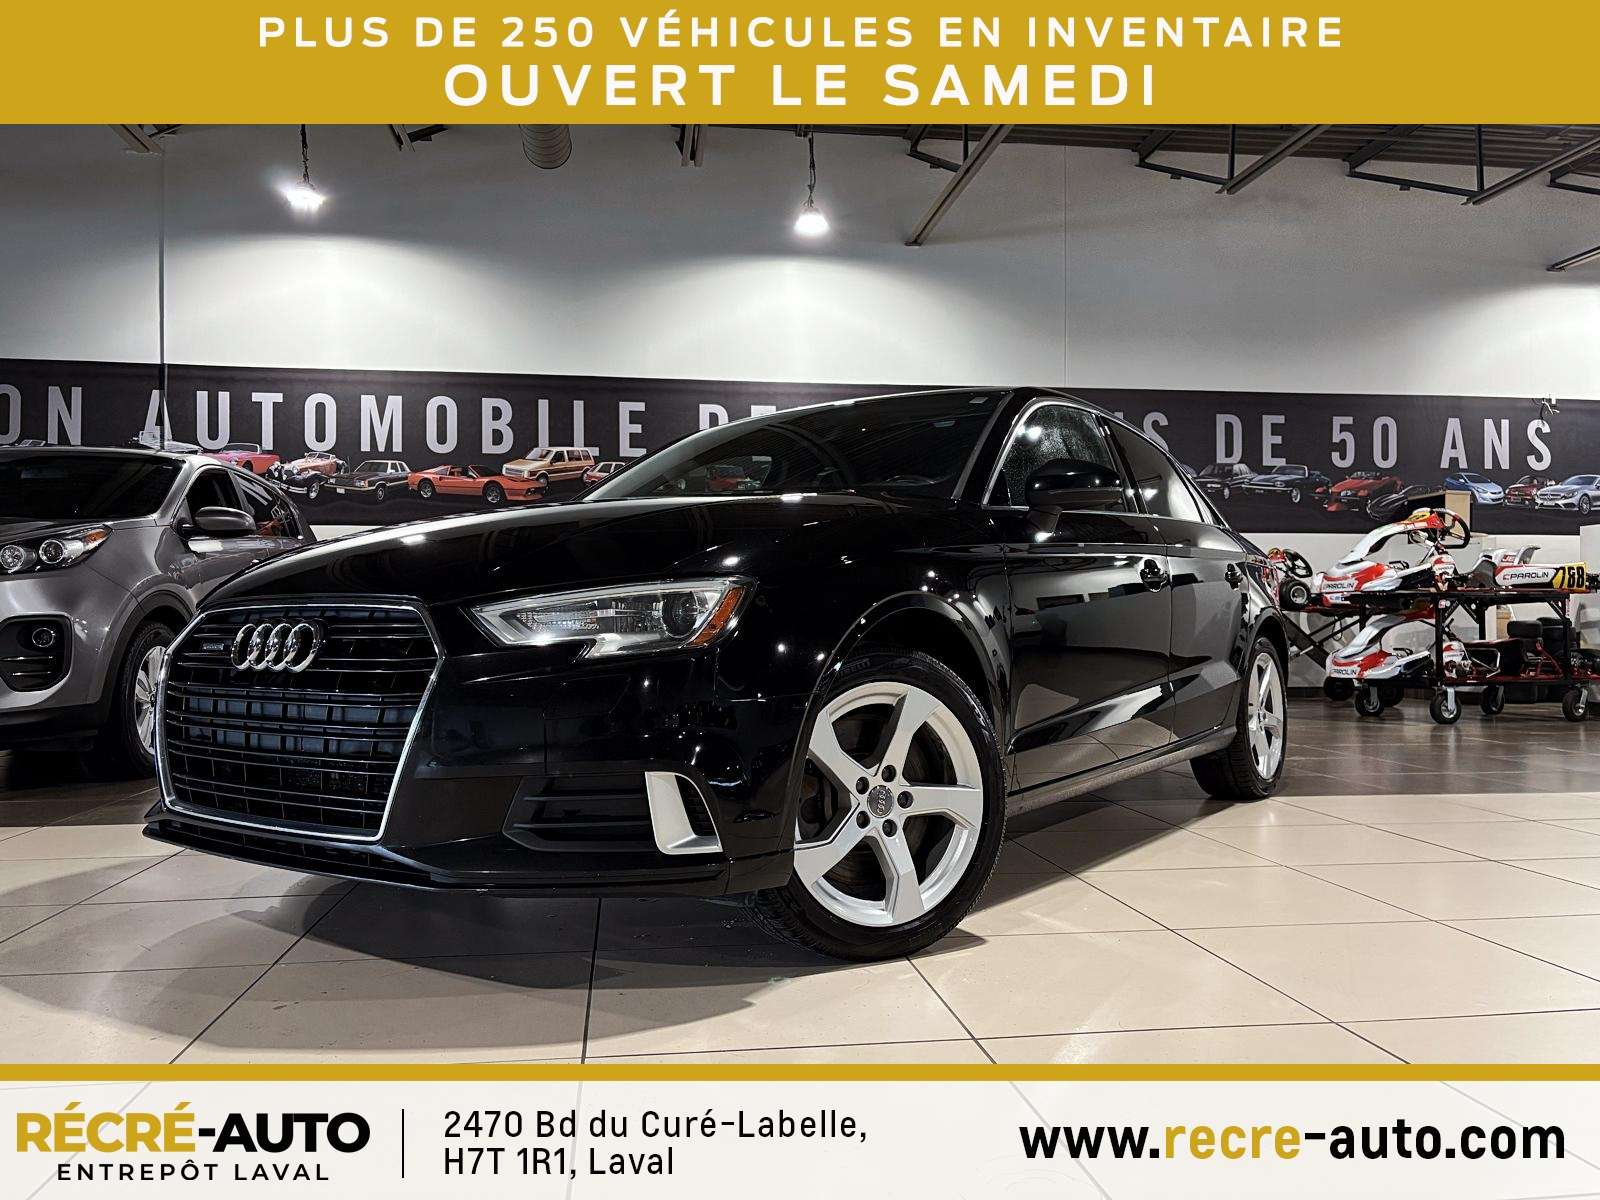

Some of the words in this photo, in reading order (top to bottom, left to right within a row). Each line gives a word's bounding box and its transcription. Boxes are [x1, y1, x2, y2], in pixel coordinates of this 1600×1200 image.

[143, 389, 647, 458] AUTOMOBILE
[1215, 413, 1287, 466] DE
[1331, 415, 1398, 469] 50
[1439, 416, 1552, 471] ANS
